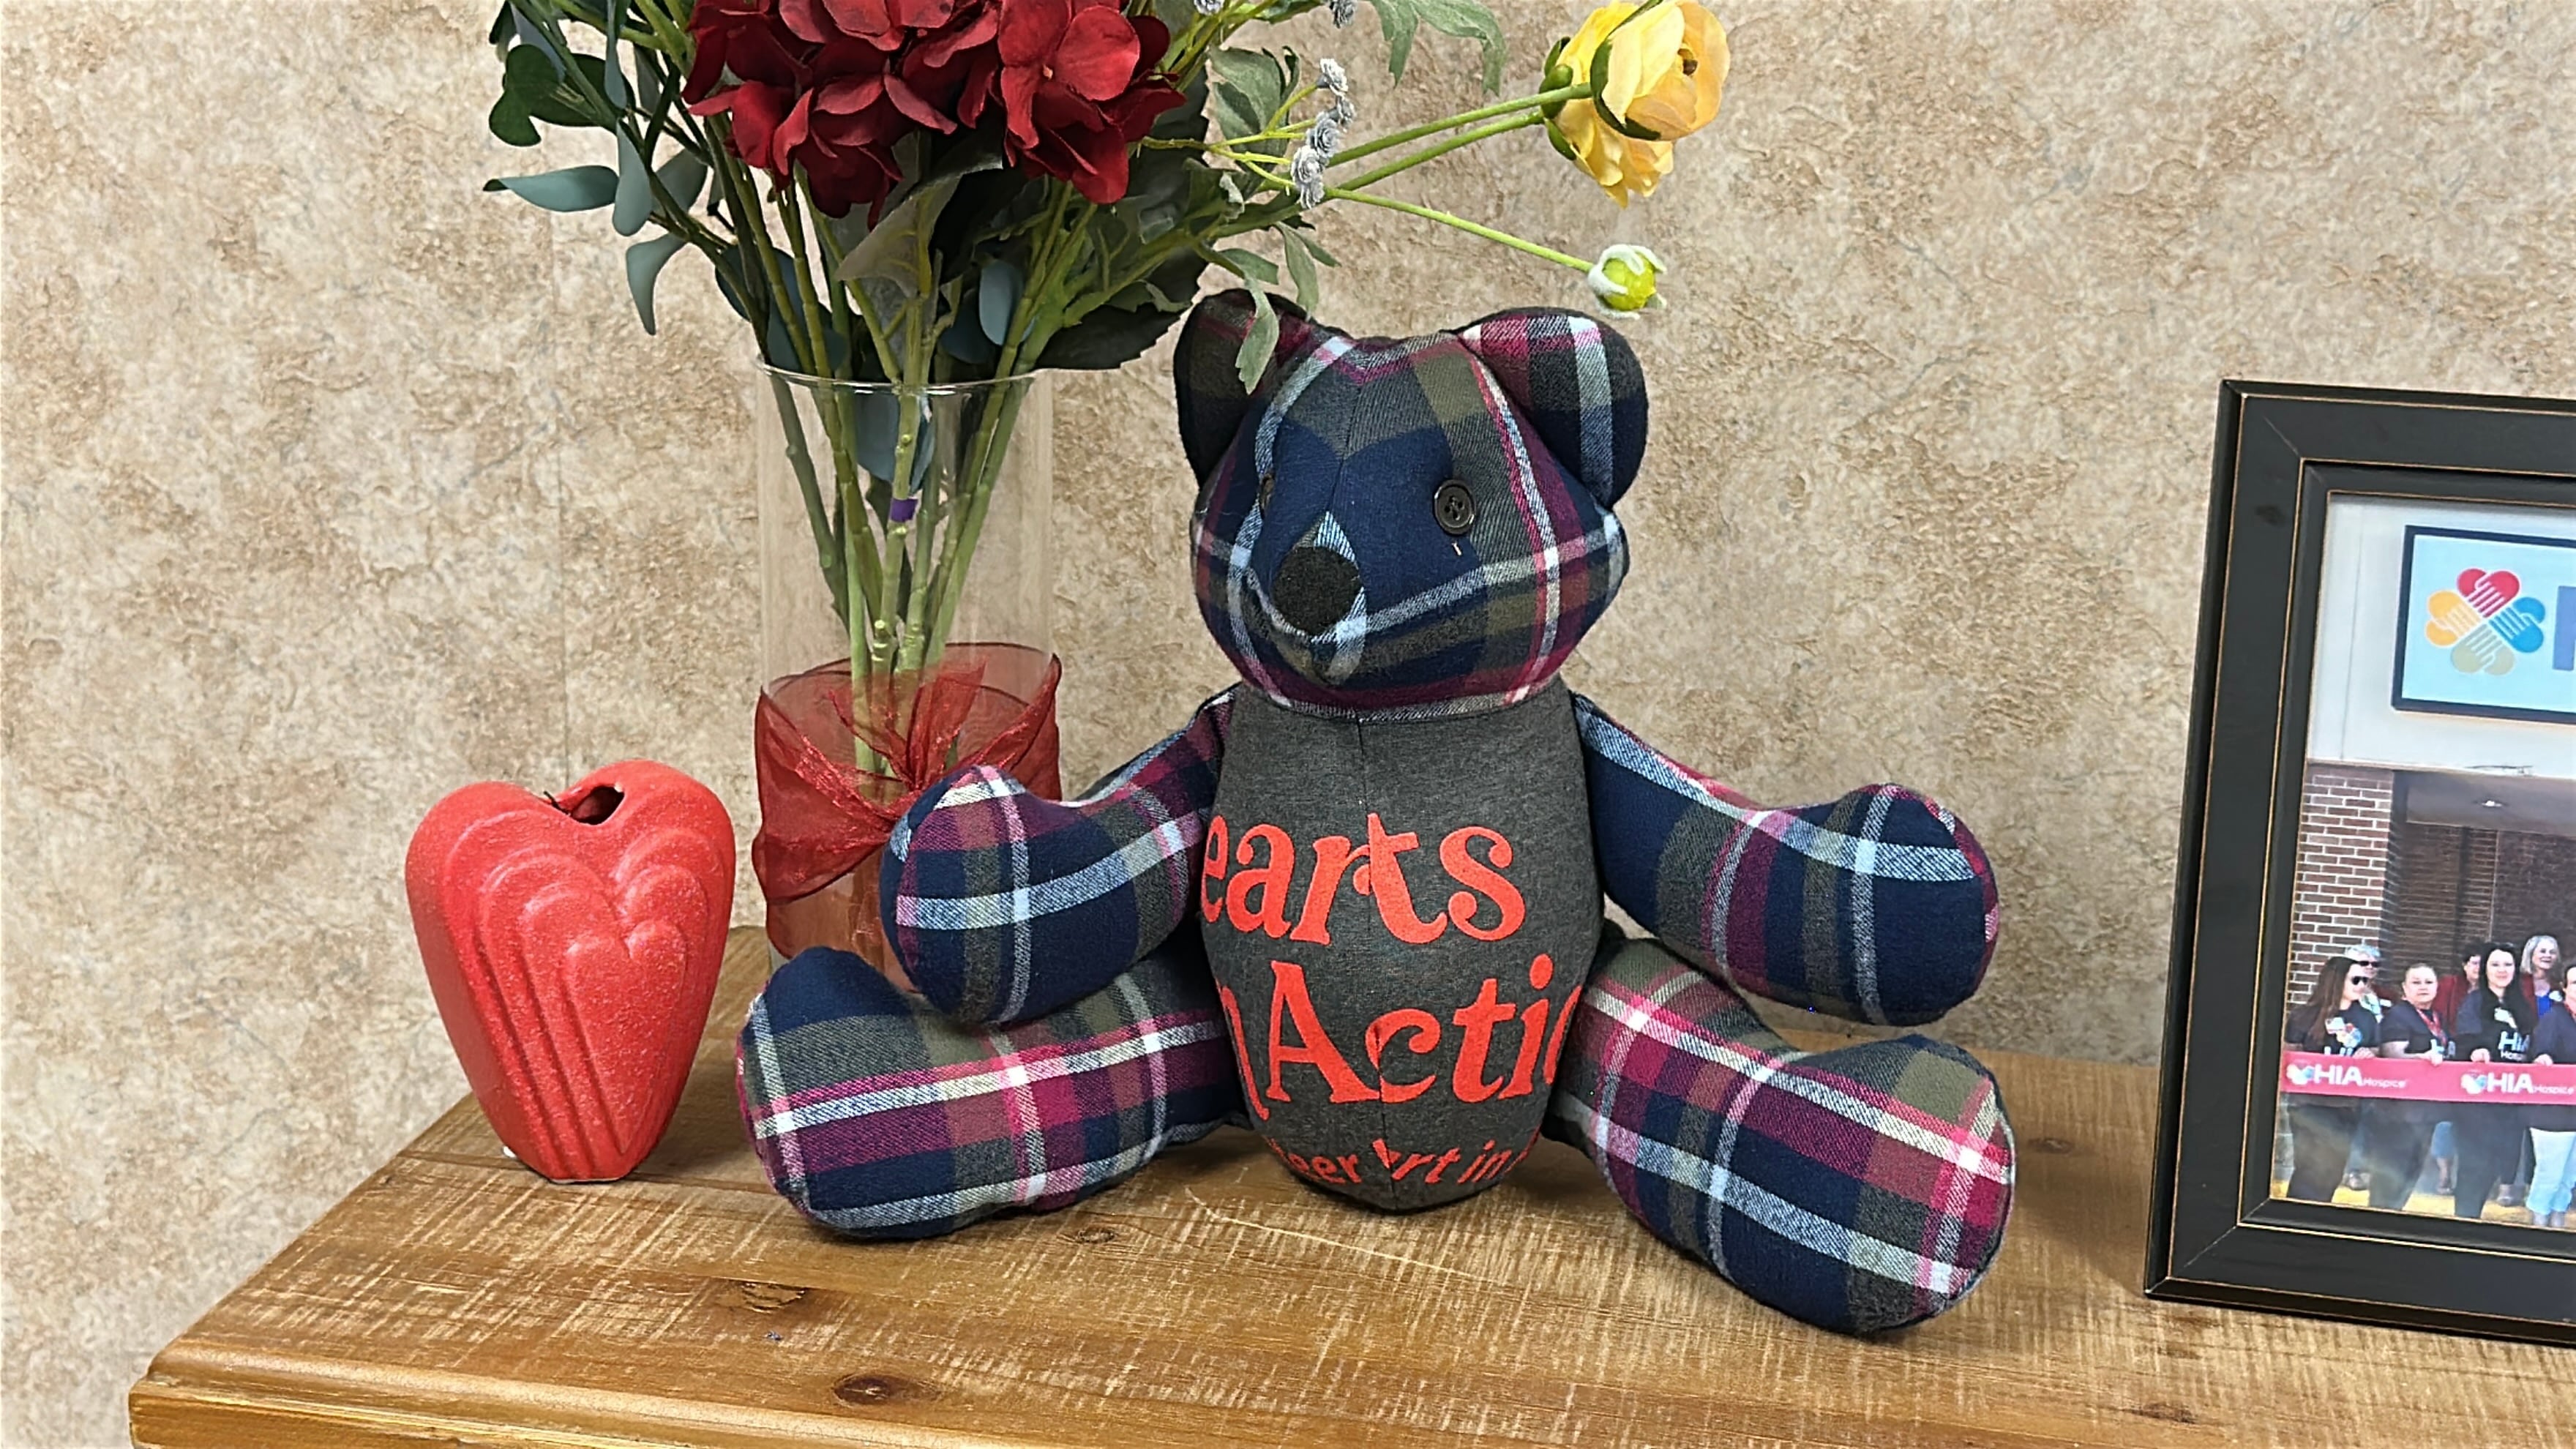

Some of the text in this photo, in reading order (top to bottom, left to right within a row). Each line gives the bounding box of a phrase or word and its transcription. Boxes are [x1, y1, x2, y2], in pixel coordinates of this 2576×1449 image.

[1201, 812, 1526, 946] earts
[2313, 1063, 2364, 1087] HIA
[2487, 1071, 2534, 1094] HIA
[1272, 1137, 1362, 1183] eer
